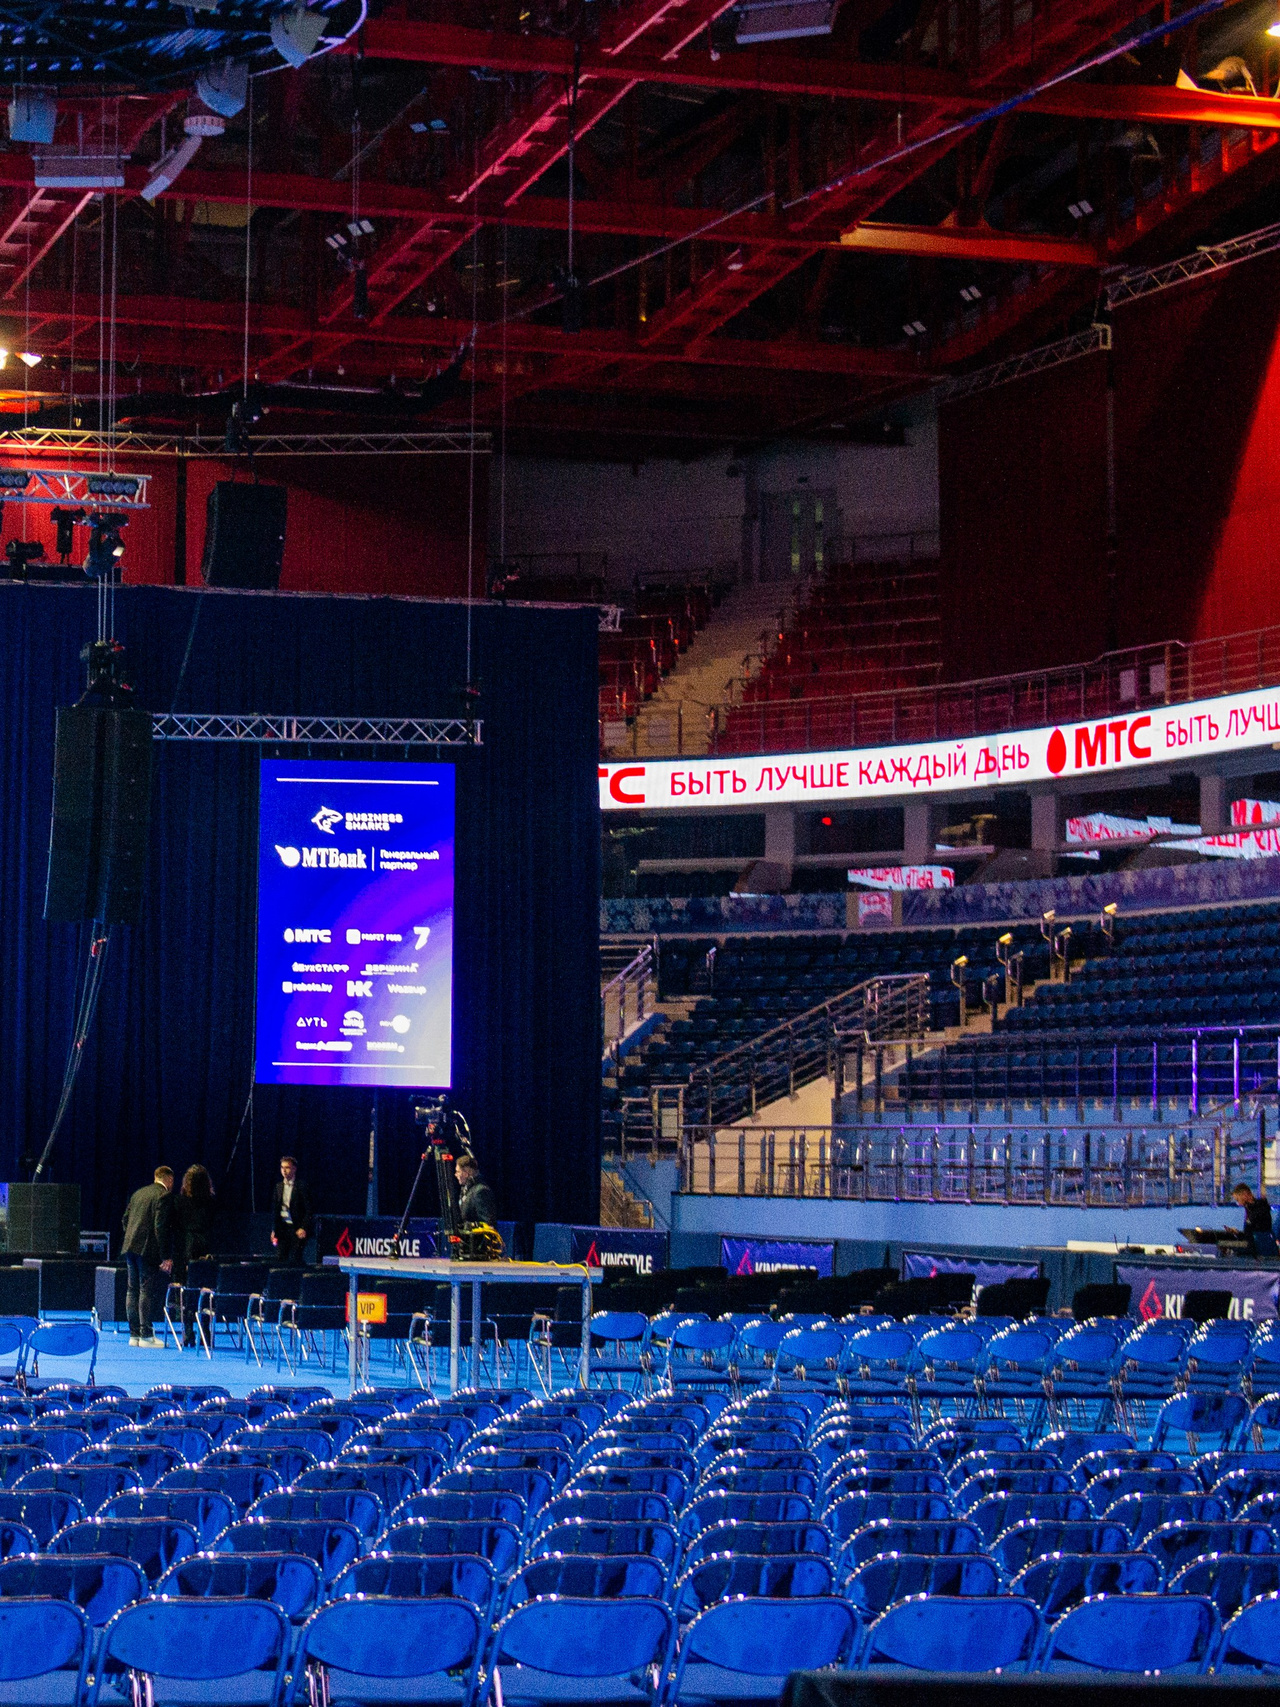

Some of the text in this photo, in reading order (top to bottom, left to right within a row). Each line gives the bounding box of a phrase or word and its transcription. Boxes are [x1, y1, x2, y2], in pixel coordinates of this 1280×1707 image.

[598, 767, 645, 804] С
[670, 769, 747, 797] БЫТЬ
[755, 762, 850, 792] ЛУЧШЕ
[858, 743, 967, 788] КАЖДЫЙ
[1074, 715, 1152, 769] МТС
[1166, 714, 1220, 748] БЫТЬ
[345, 812, 403, 823] BUSINESS
[345, 821, 390, 831] SHARKS
[294, 928, 332, 943] МТС
[360, 1302, 375, 1315] VIP
